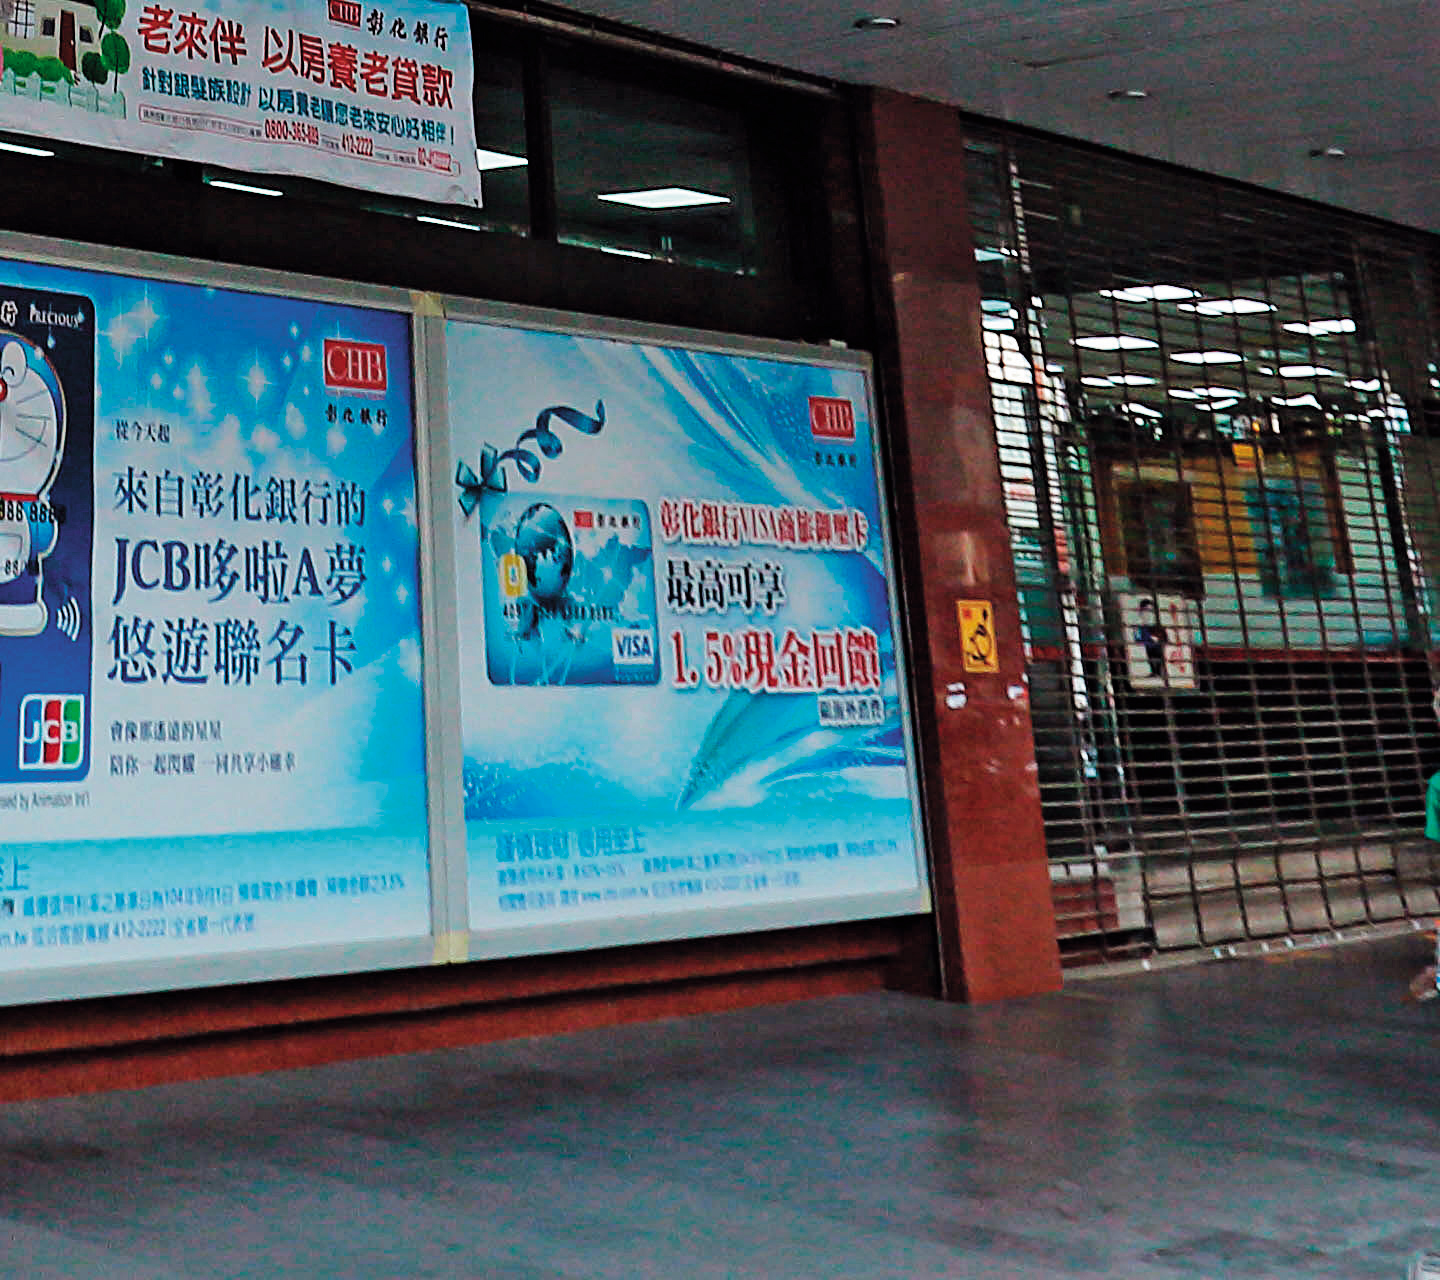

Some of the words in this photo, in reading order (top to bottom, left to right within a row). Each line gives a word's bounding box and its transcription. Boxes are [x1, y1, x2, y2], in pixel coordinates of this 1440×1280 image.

[367, 9, 448, 52] 彰化銀行
[137, 4, 247, 66] 老來伴
[261, 26, 455, 110] 以房養老貸款
[327, 345, 384, 382] CHB
[115, 419, 170, 443] 從今天起
[811, 402, 853, 433] CHB
[112, 466, 366, 528] 來自彰化銀行的
[112, 537, 368, 606] JCB哆啦A夢
[667, 559, 786, 610] 最高可享
[107, 615, 358, 686] 悠遊聯名卡
[614, 634, 652, 658] VISA
[23, 719, 79, 744] JCB
